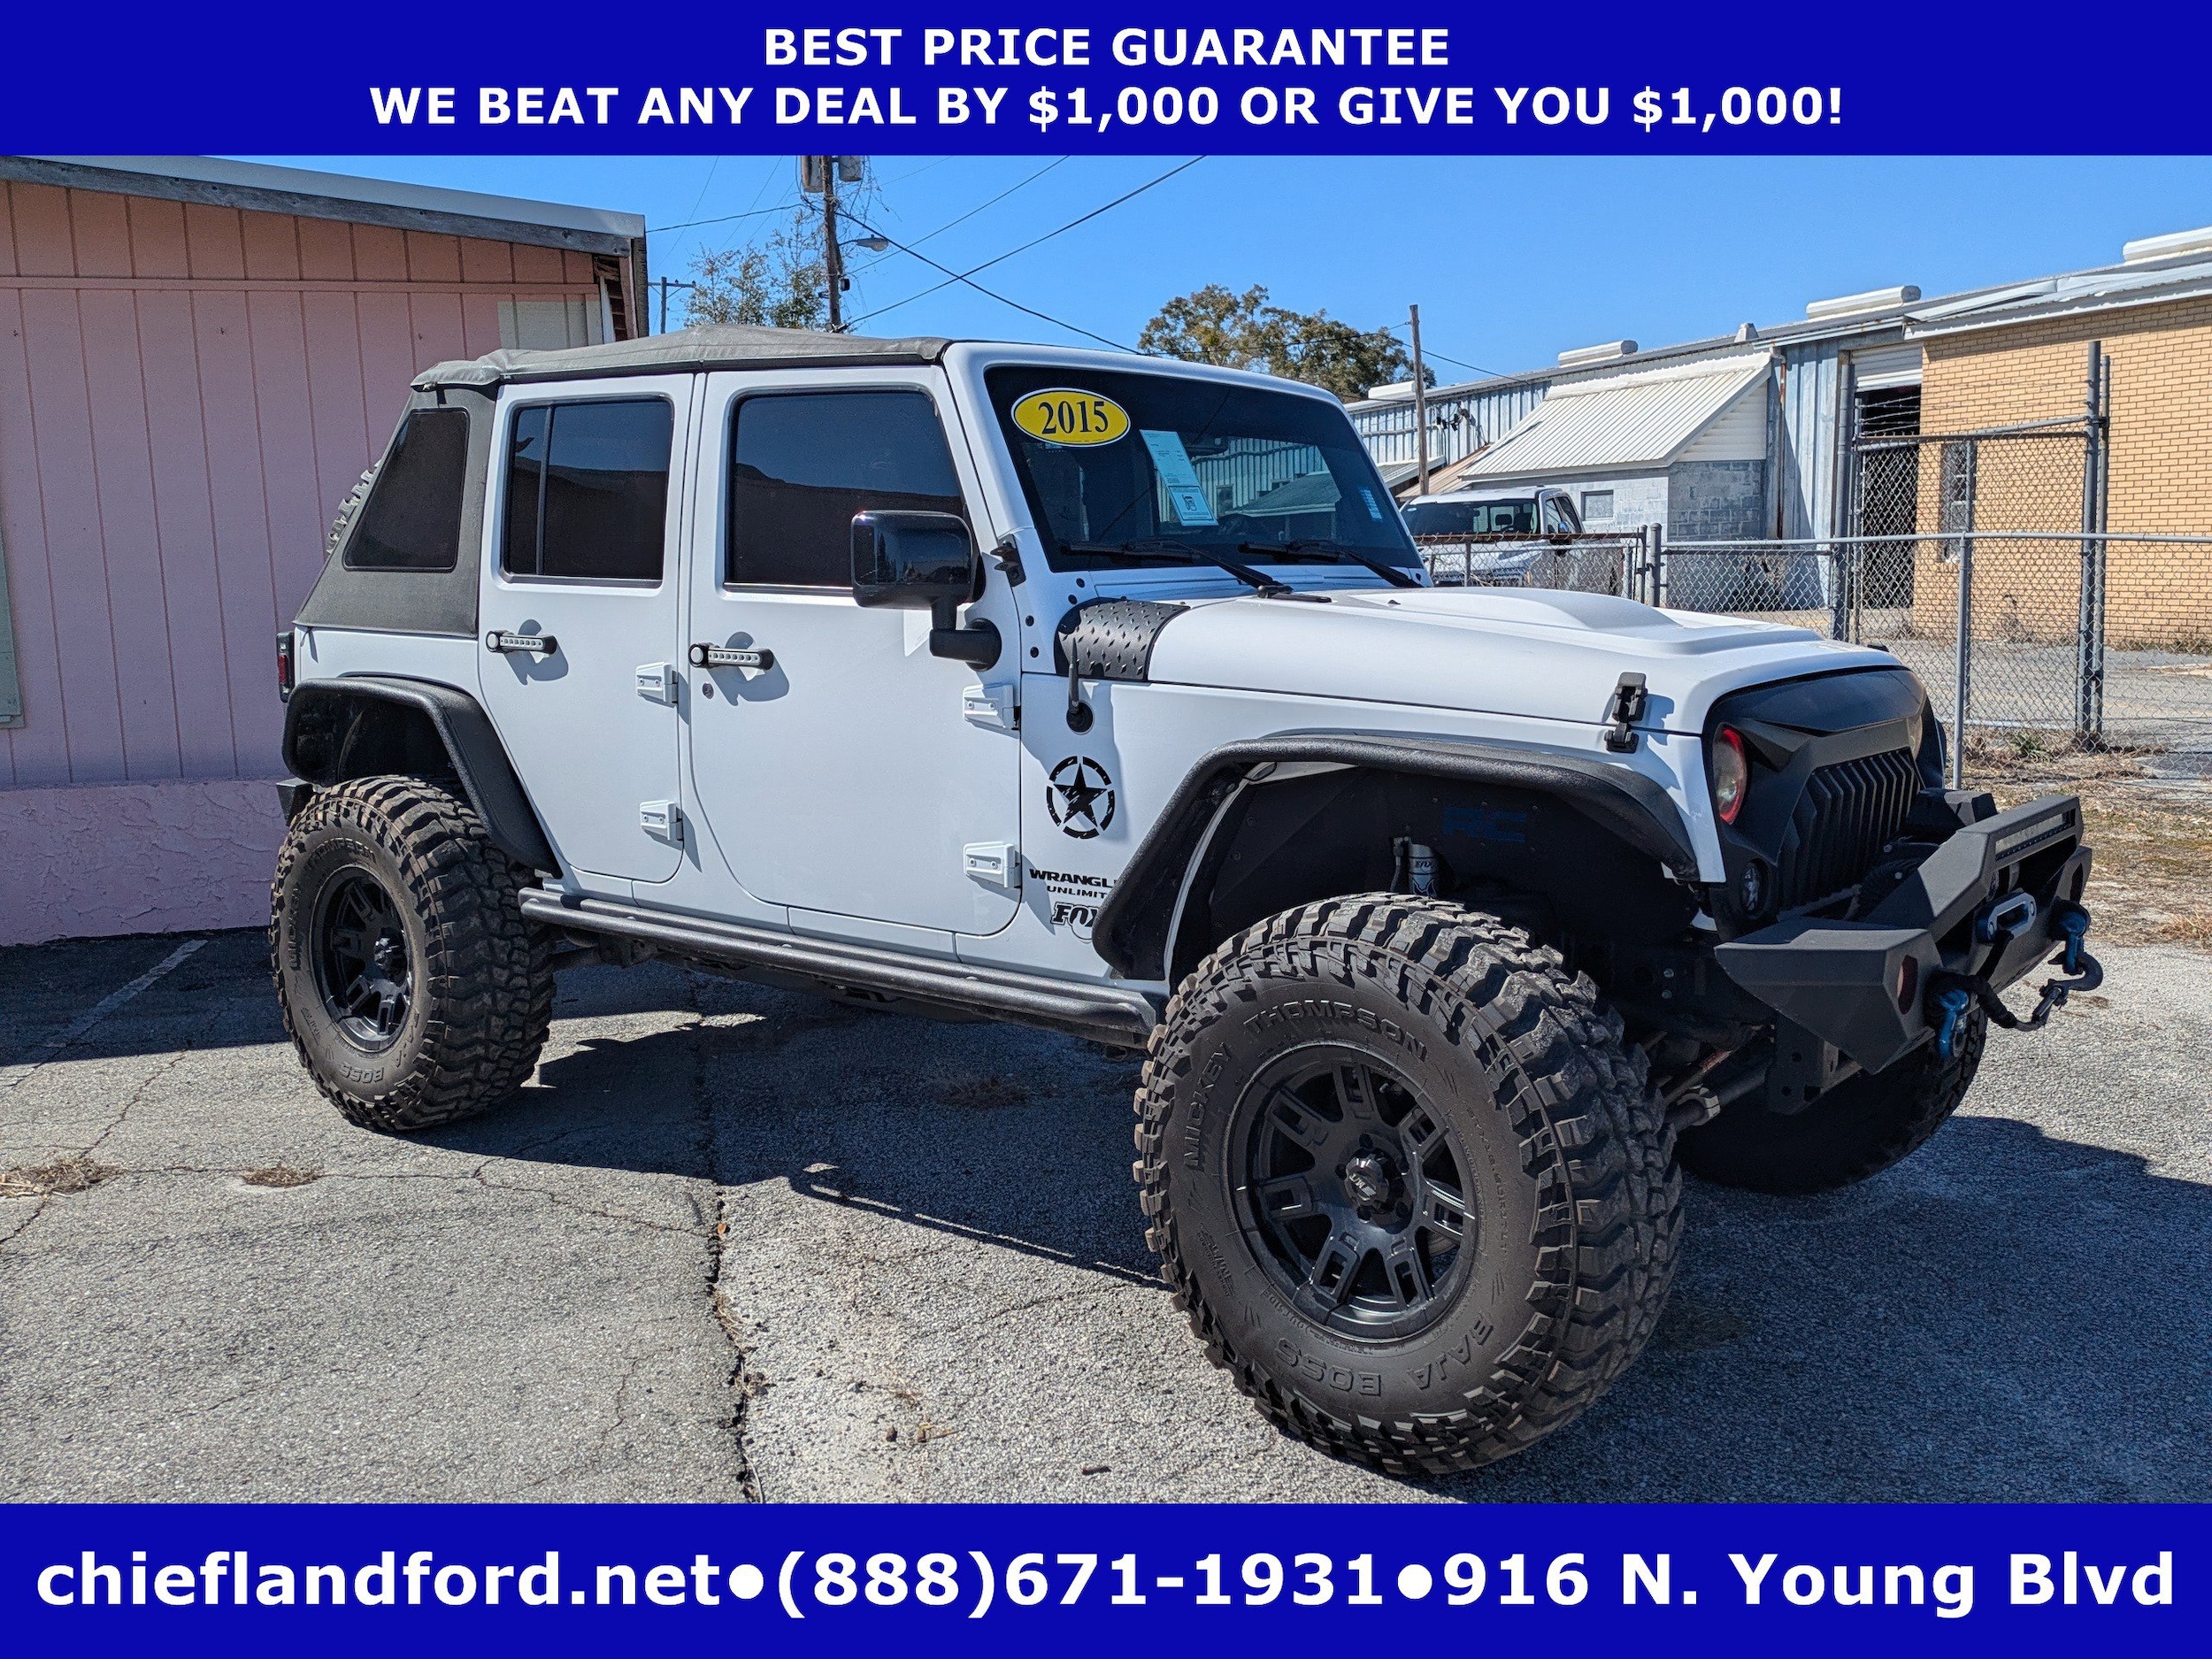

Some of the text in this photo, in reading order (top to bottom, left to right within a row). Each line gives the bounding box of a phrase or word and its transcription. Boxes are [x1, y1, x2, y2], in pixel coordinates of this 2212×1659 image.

[1039, 401, 1109, 434] 2015
[1029, 868, 1117, 888] WRANGL
[338, 1063, 385, 1084] BOSS
[1184, 999, 1429, 1168] MICKEY THOMPSON
[1274, 1311, 1494, 1397] BAJA BOSS
